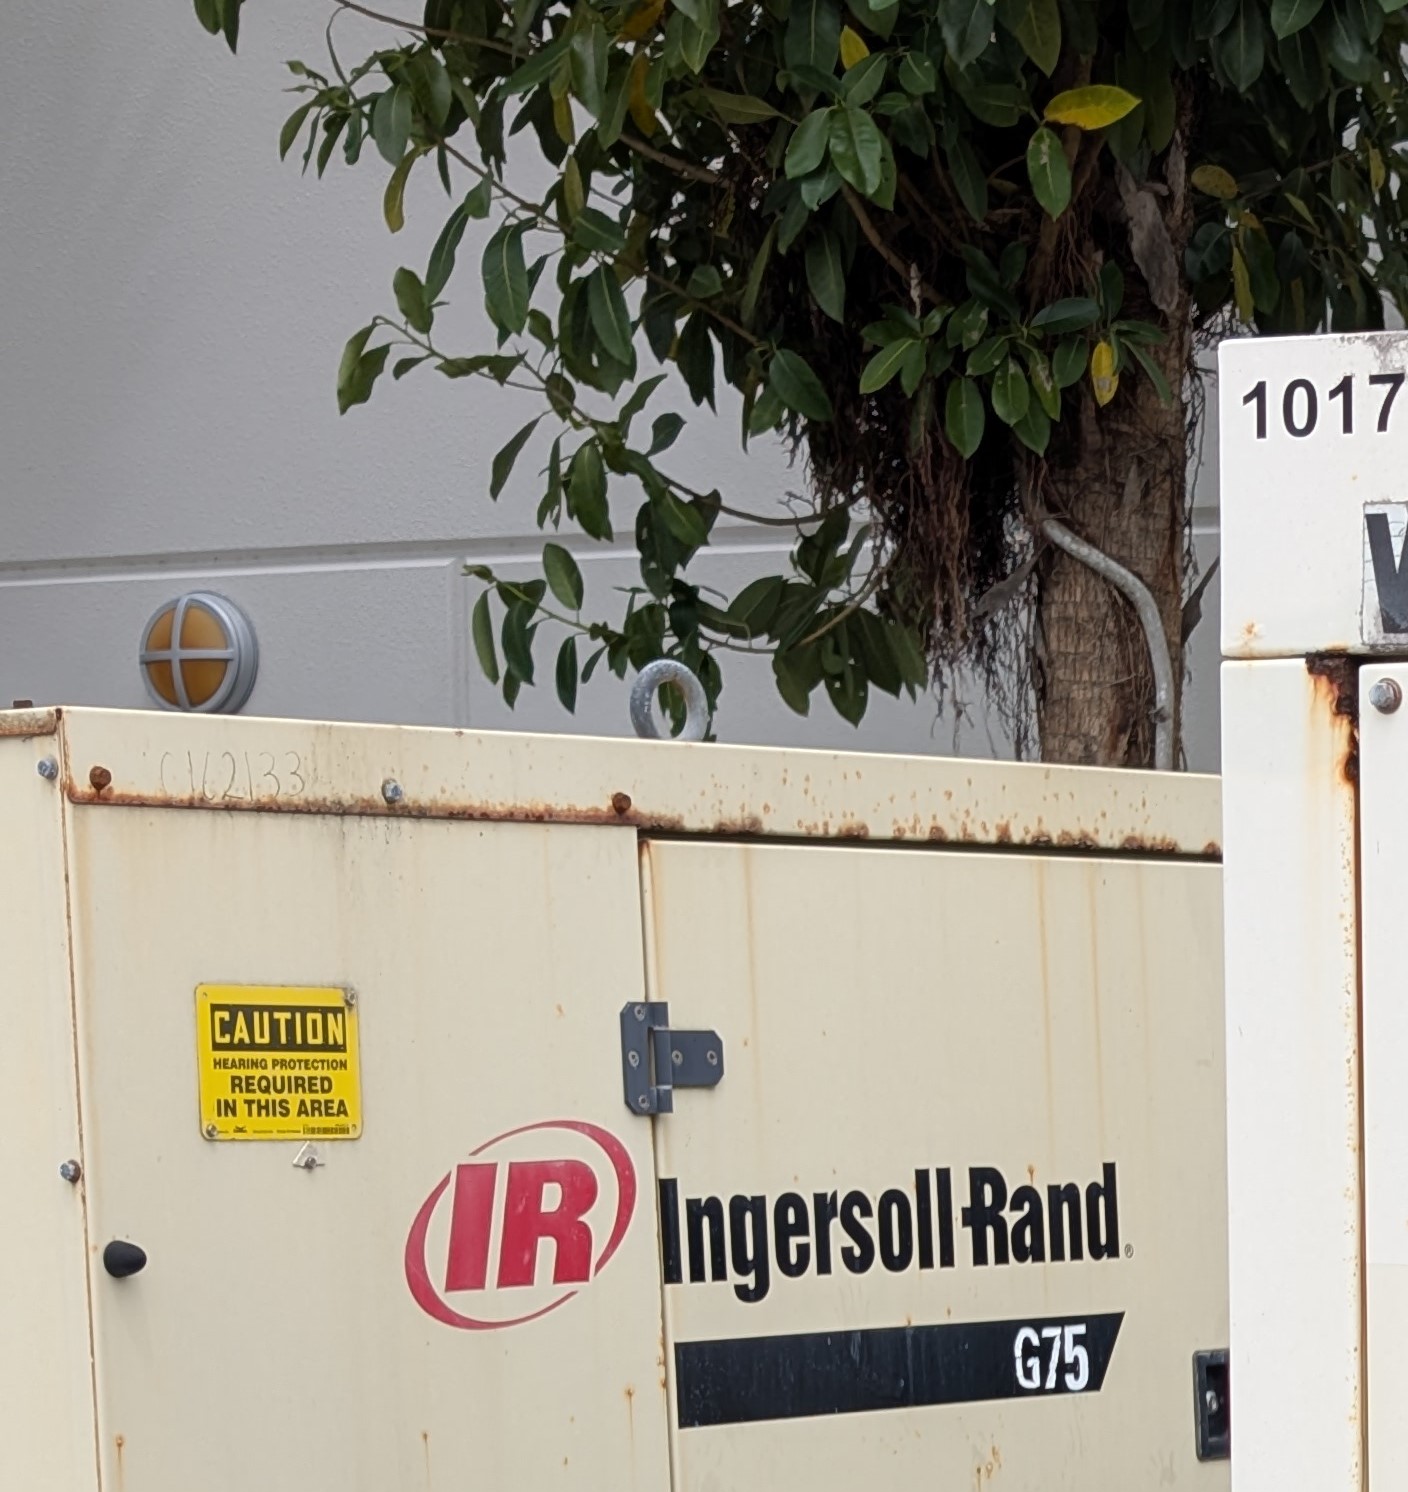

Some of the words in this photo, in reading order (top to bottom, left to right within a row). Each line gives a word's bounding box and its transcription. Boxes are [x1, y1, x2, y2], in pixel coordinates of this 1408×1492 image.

[214, 1010, 344, 1045] CAUTION
[213, 1057, 268, 1070] HEARING
[271, 1058, 348, 1071] PROTECTION
[230, 1075, 333, 1095] REQUIRED
[216, 1098, 237, 1118] IN
[243, 1098, 291, 1118] THIS
[296, 1098, 349, 1118] AREA
[444, 1160, 599, 1292] IR
[1014, 1323, 1090, 1391] G75
